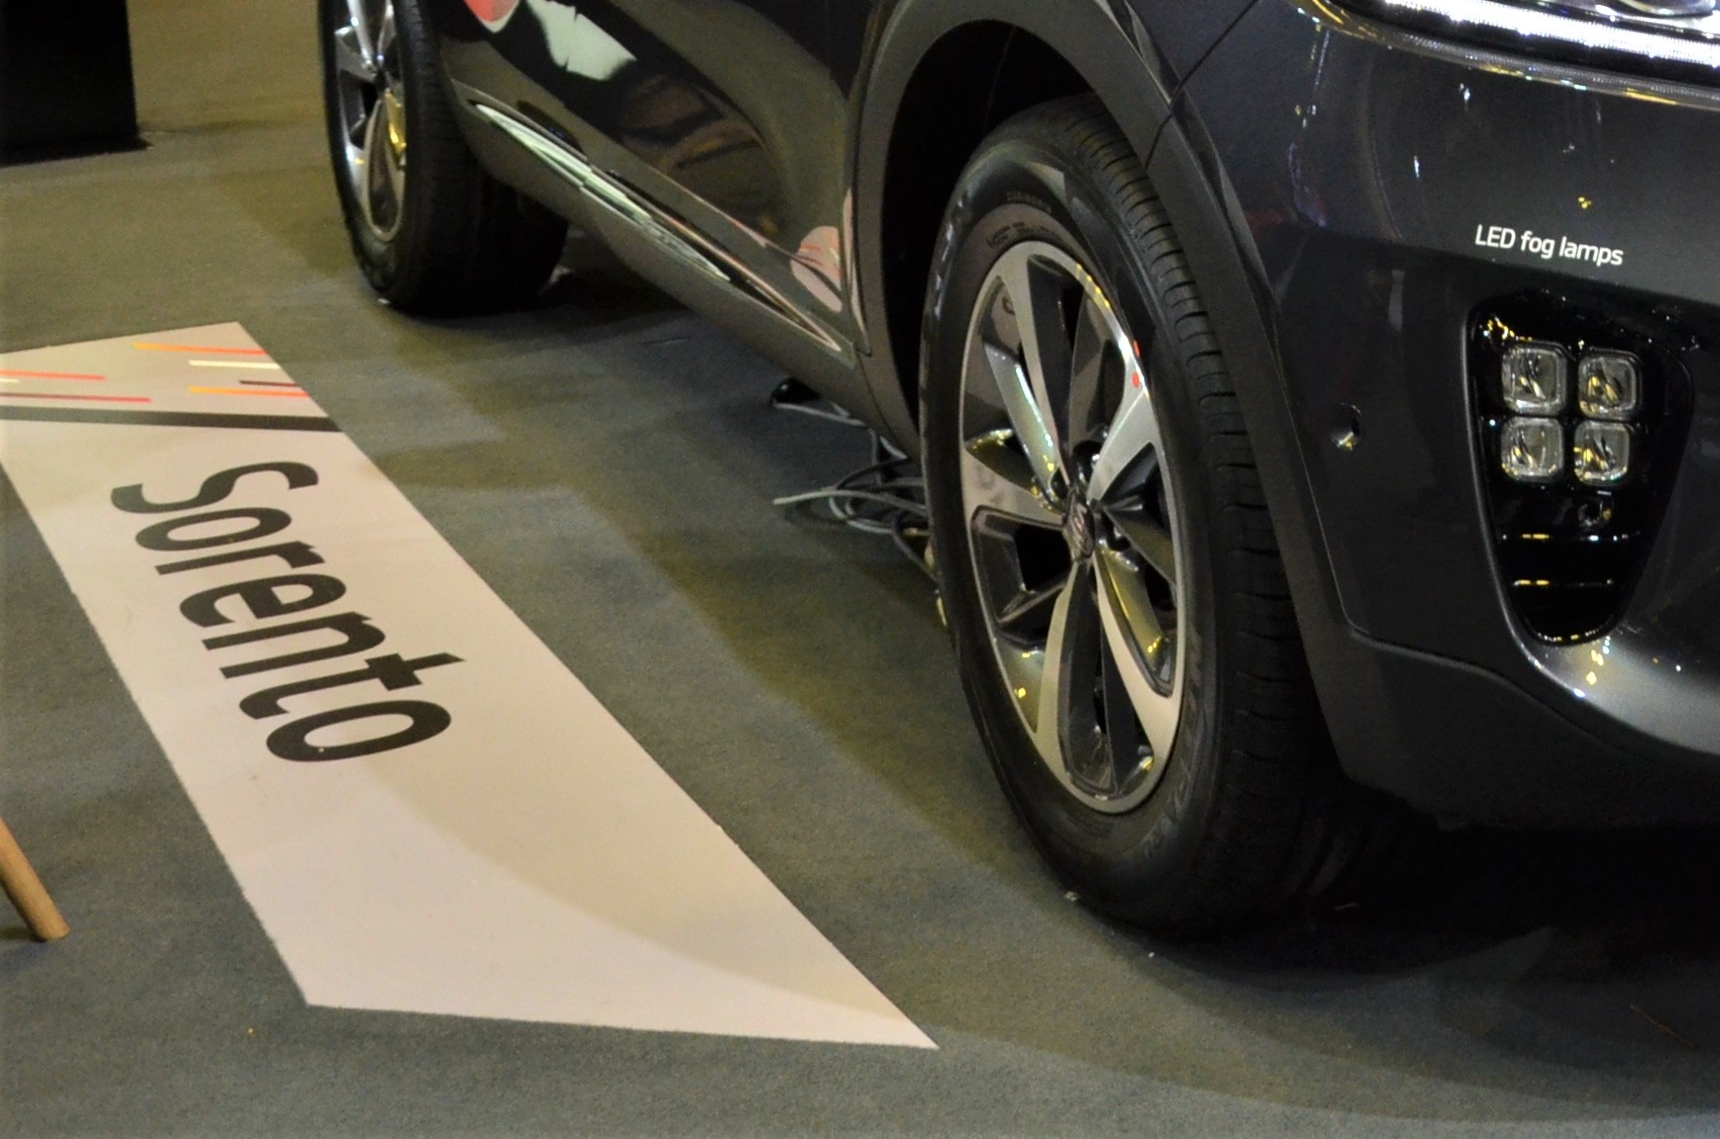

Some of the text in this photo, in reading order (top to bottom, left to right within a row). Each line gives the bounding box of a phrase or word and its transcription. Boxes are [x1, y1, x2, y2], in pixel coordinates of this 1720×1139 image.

[1475, 224, 1624, 267] LED fog lamps
[110, 461, 466, 763] Sorento
